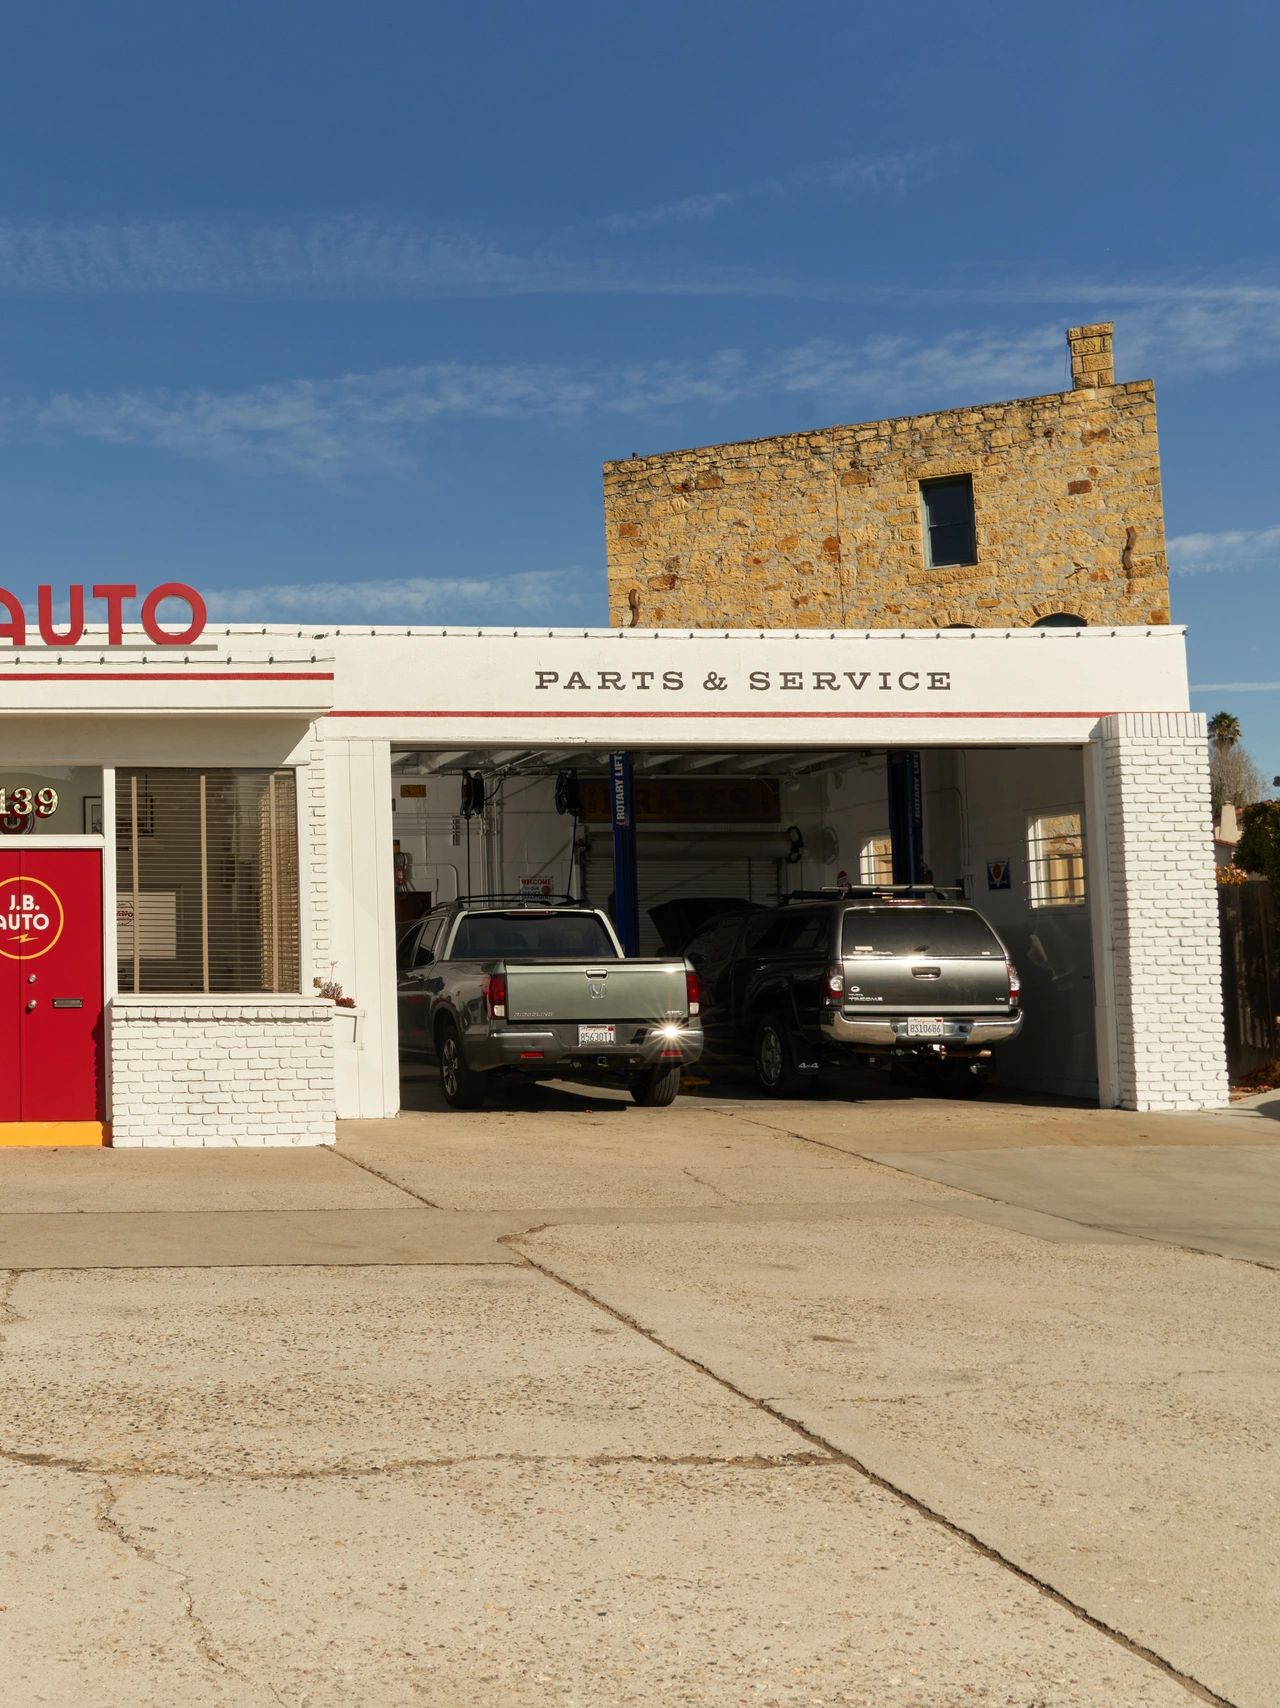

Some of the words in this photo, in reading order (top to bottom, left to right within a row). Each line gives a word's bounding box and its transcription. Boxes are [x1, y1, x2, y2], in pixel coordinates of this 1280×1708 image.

[535, 671, 684, 691] PARTS
[702, 671, 728, 691] &
[750, 671, 951, 691] SERVICE
[616, 779, 625, 820] ROTARY
[9, 894, 40, 911] J.B.
[910, 1024, 941, 1033] 8S10686
